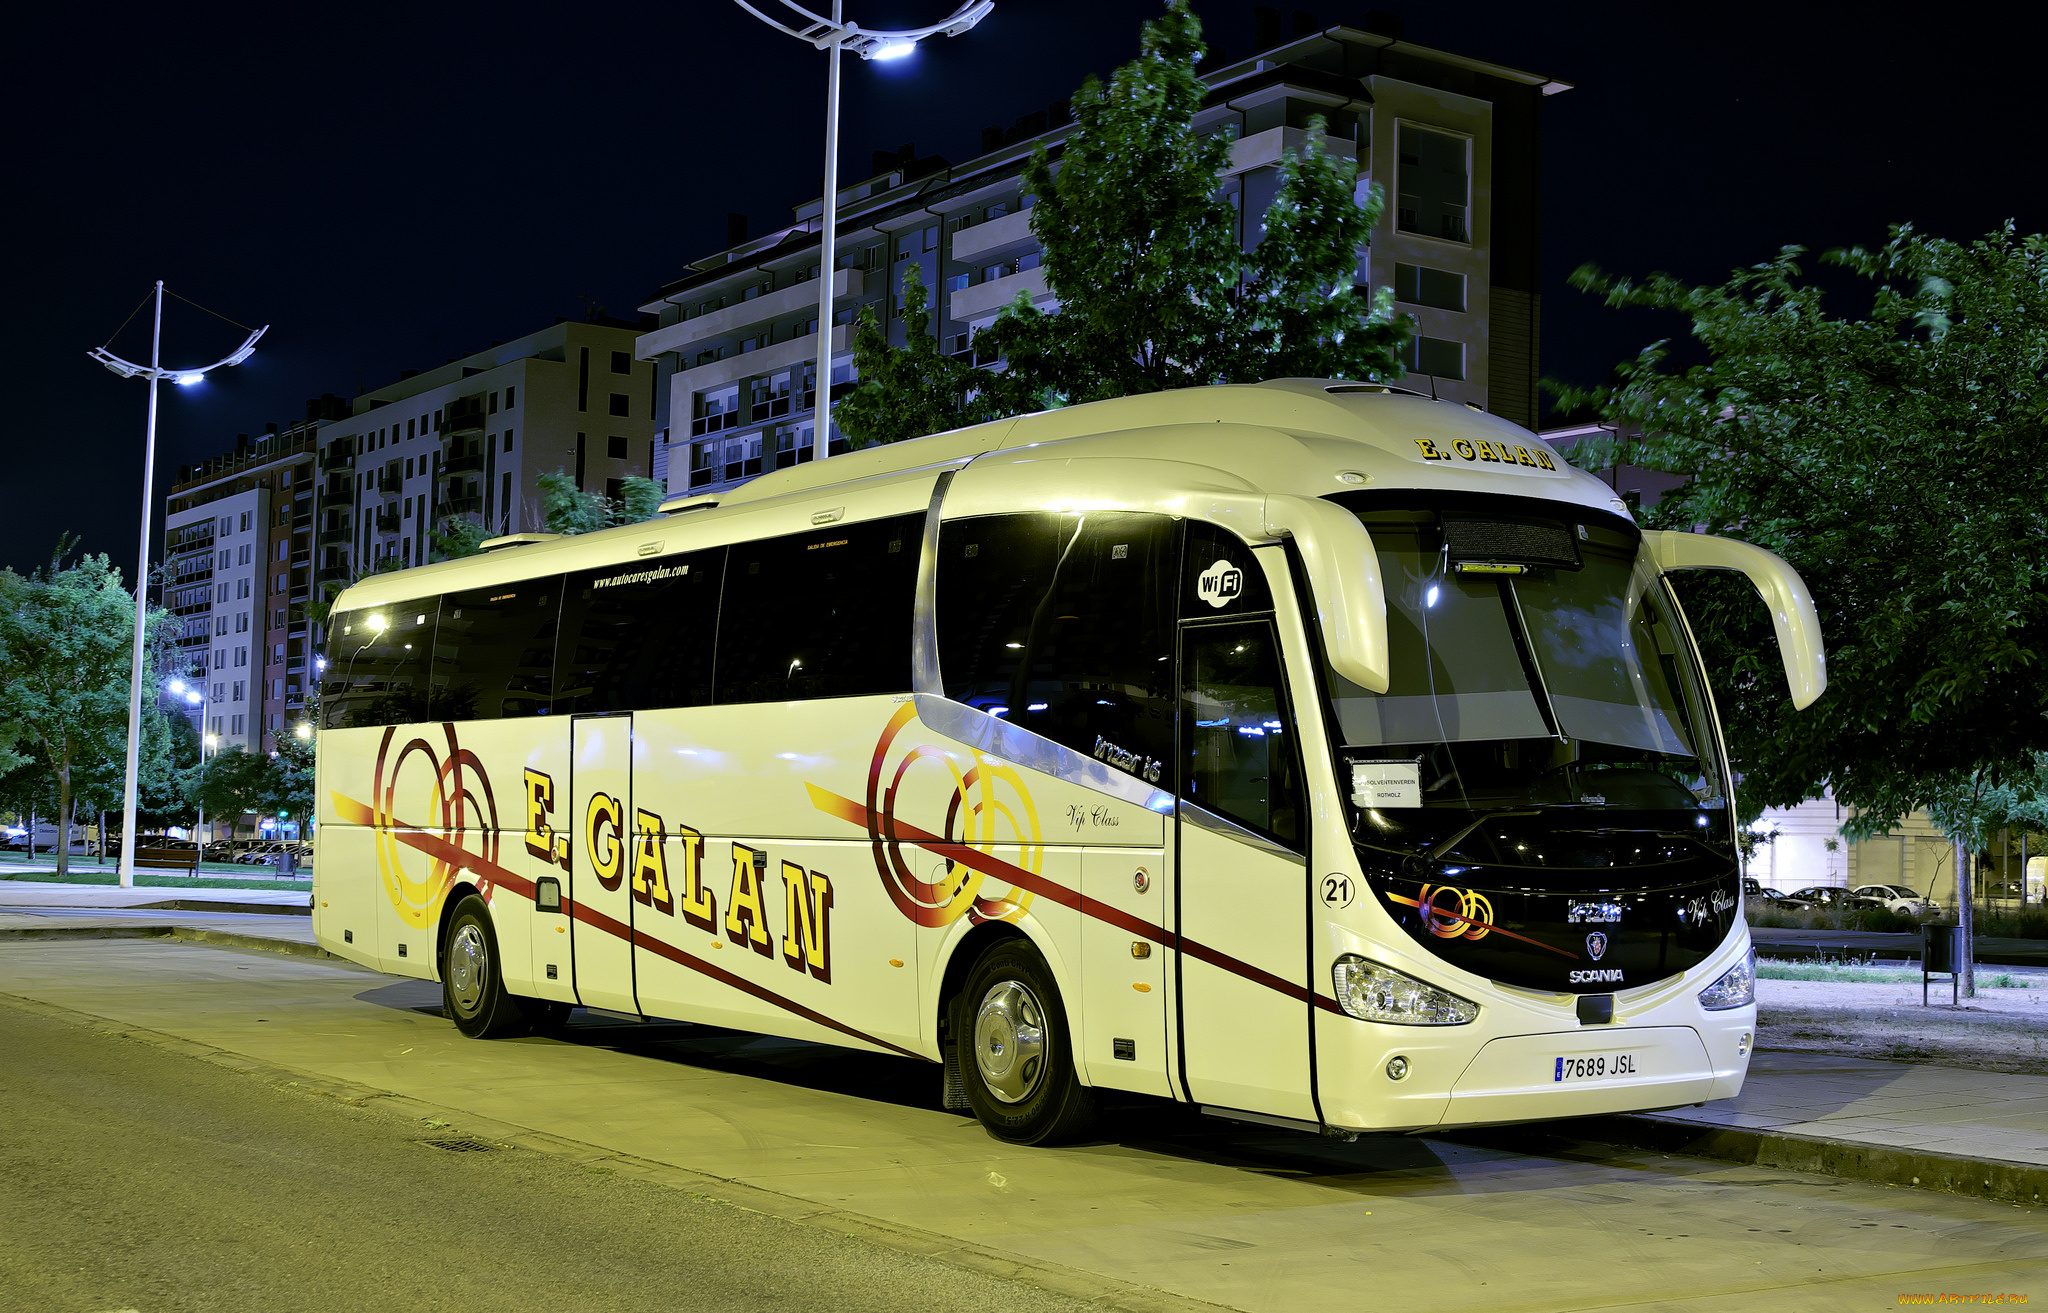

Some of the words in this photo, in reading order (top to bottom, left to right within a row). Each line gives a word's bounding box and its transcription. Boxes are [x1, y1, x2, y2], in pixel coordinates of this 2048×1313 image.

[1414, 438, 1451, 460] E.
[1452, 438, 1557, 472] GALAN
[593, 564, 689, 589] www.autocaresgalan.com
[1065, 804, 1086, 833] Vip
[1090, 803, 1120, 827] Class
[523, 766, 571, 872] E.
[585, 791, 834, 986] GALAN
[1325, 878, 1348, 902] 21
[1710, 888, 1735, 915] Class
[1568, 968, 1624, 984] SCANIA
[1565, 1057, 1605, 1079] 7689
[1610, 1054, 1636, 1075] JSL
